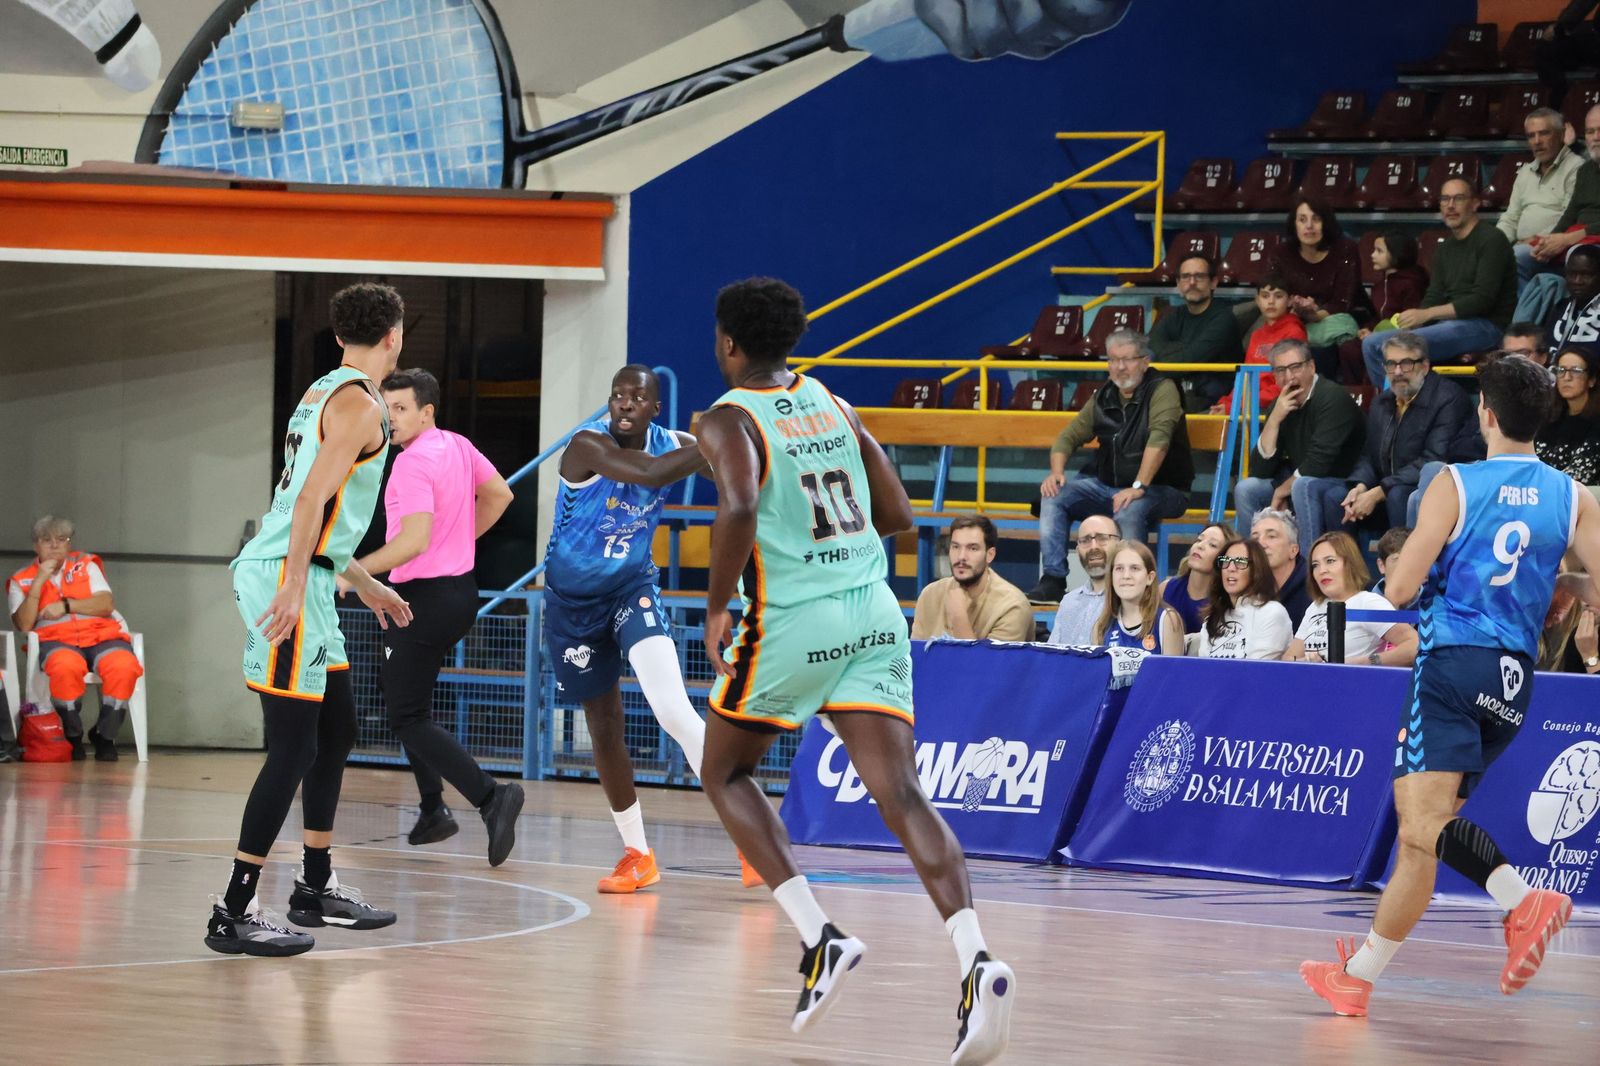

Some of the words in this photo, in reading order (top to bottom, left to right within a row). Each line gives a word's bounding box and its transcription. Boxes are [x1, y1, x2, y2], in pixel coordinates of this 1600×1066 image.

[1336, 97, 1352, 110] 82
[1523, 93, 1538, 106] 76
[23, 149, 65, 166] EMERGENCIA
[1206, 164, 1221, 178] 82
[1265, 164, 1281, 178] 80
[1326, 163, 1339, 176] 78
[1388, 163, 1402, 175] 76
[1449, 162, 1463, 175] 74
[1190, 239, 1204, 252] 78
[1250, 239, 1264, 252] 76
[1056, 312, 1071, 326] 78
[1114, 312, 1128, 325] 76
[914, 385, 929, 400] 78
[1032, 387, 1046, 400] 74
[1498, 485, 1539, 506] PERIS
[799, 467, 867, 543] 10
[603, 534, 634, 559] 15
[1489, 520, 1531, 586] 9
[818, 548, 849, 564] THB
[1475, 692, 1523, 726] MORALEJO
[1543, 719, 1581, 734] Consejo
[1202, 774, 1350, 816] SALAMANCA
